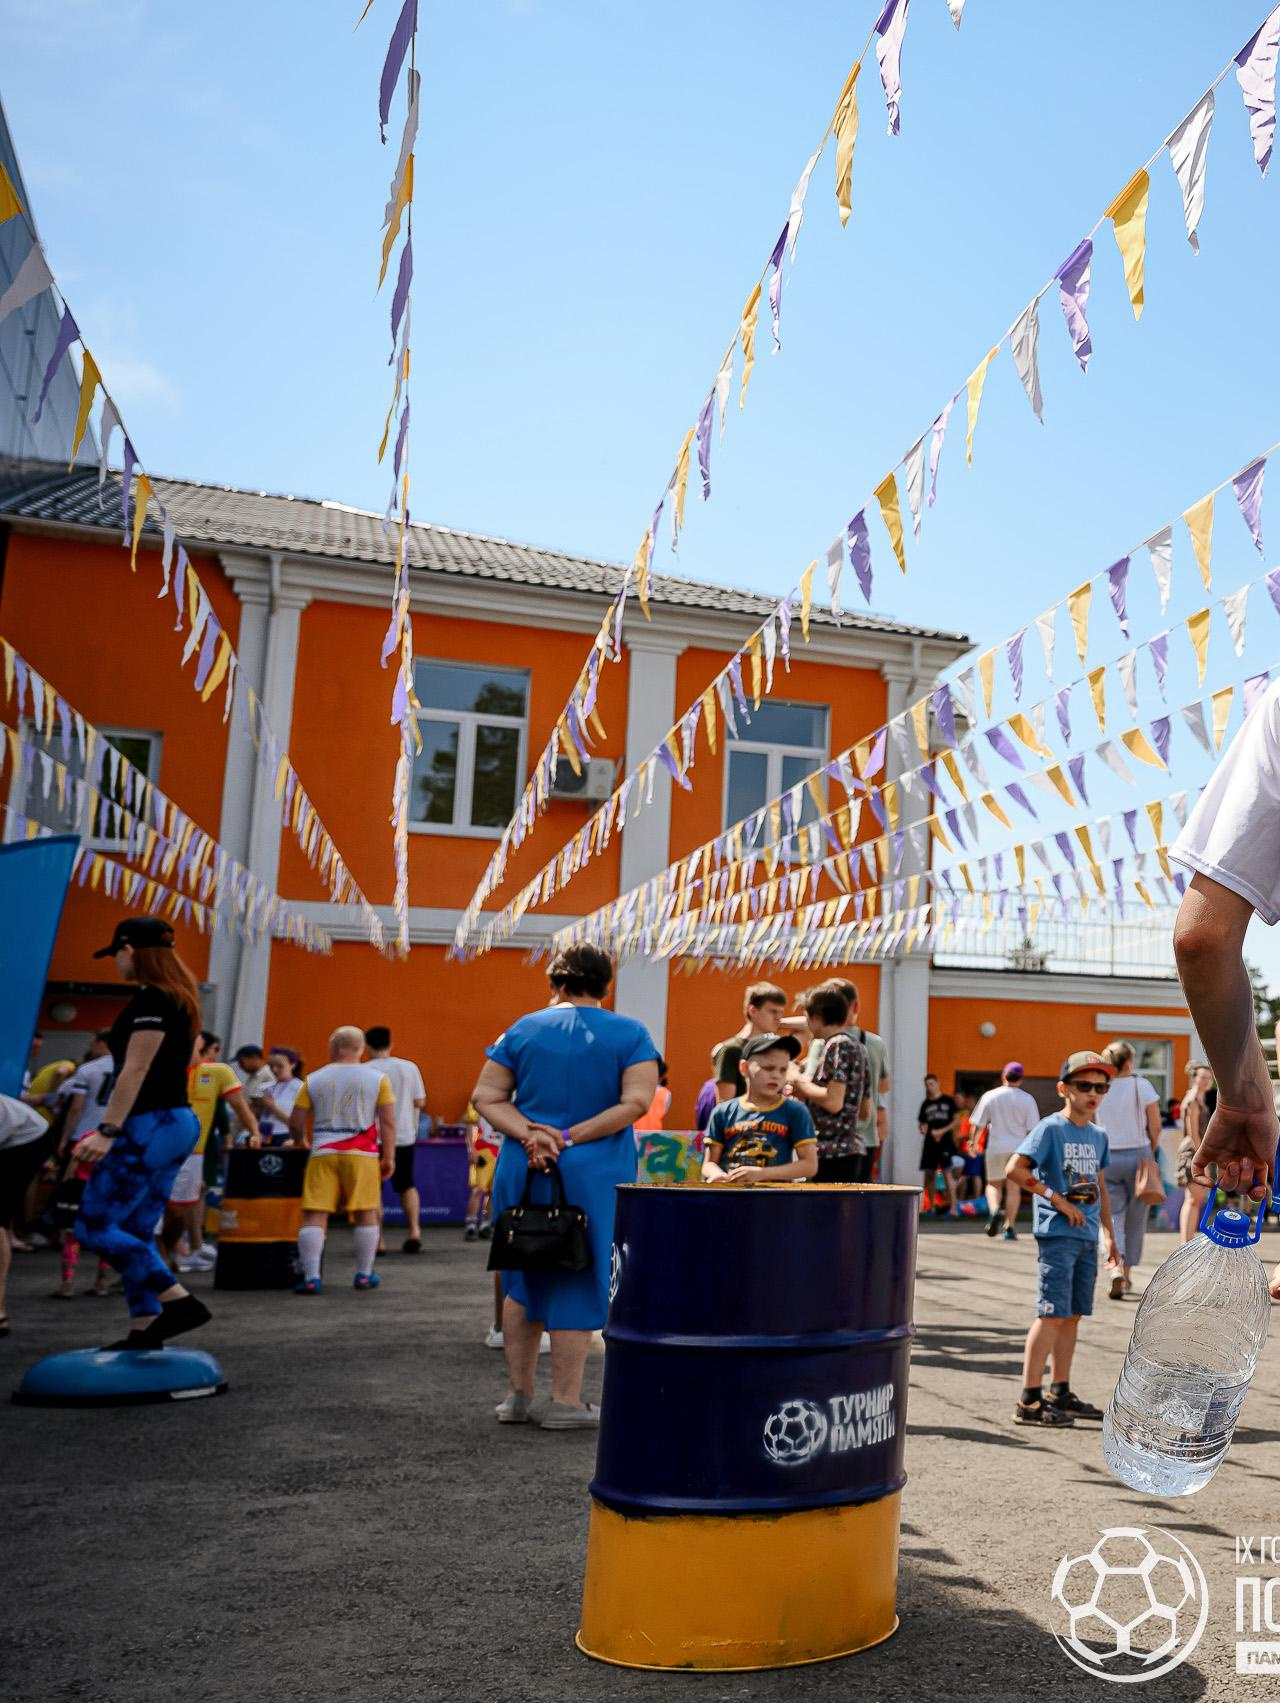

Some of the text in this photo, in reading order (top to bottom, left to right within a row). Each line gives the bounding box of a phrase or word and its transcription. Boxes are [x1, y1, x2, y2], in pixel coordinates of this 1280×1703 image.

[1063, 1142, 1096, 1158] BEACH
[829, 1383, 893, 1424] ТУРНИР
[830, 1409, 895, 1453] ПАМЯТИ
